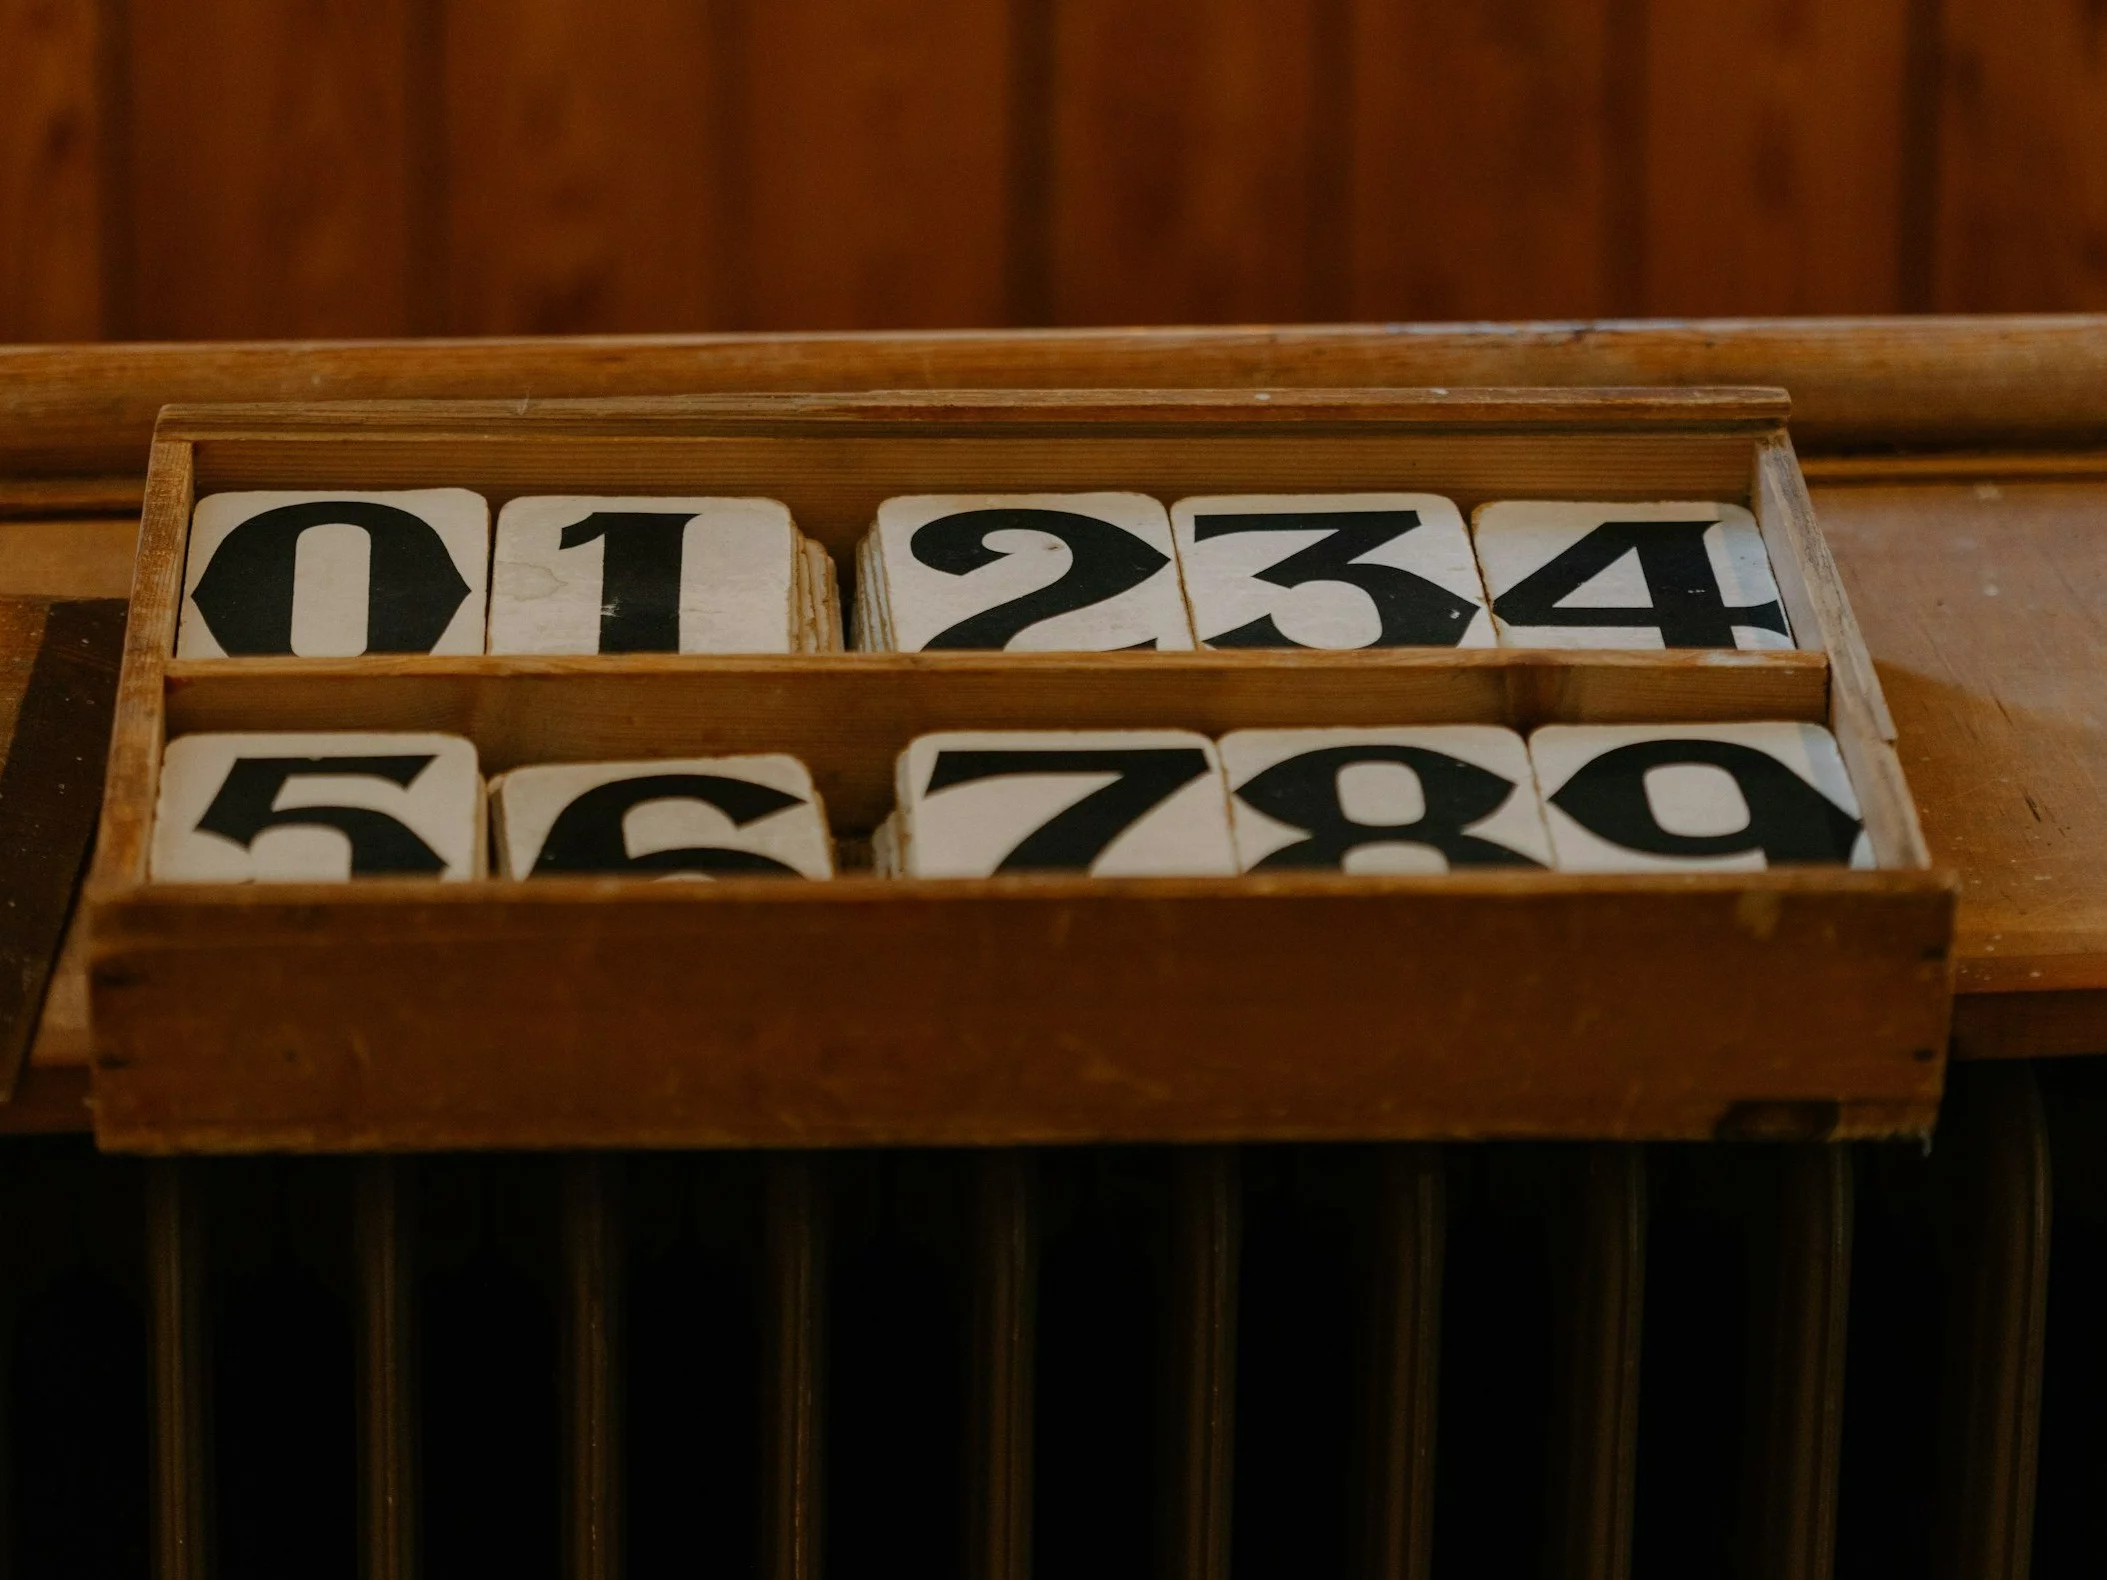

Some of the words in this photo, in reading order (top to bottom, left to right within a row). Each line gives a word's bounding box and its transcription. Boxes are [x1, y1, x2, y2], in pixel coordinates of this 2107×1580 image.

[191, 501, 471, 657] 0
[559, 512, 702, 653] 1
[910, 508, 1171, 651] 2
[1193, 510, 1480, 650] 3
[1492, 520, 1789, 650] 4
[194, 753, 450, 882] 5
[528, 774, 807, 881] 6
[924, 748, 1210, 877] 7
[1234, 744, 1549, 873] 8
[1547, 739, 1862, 870] 9
